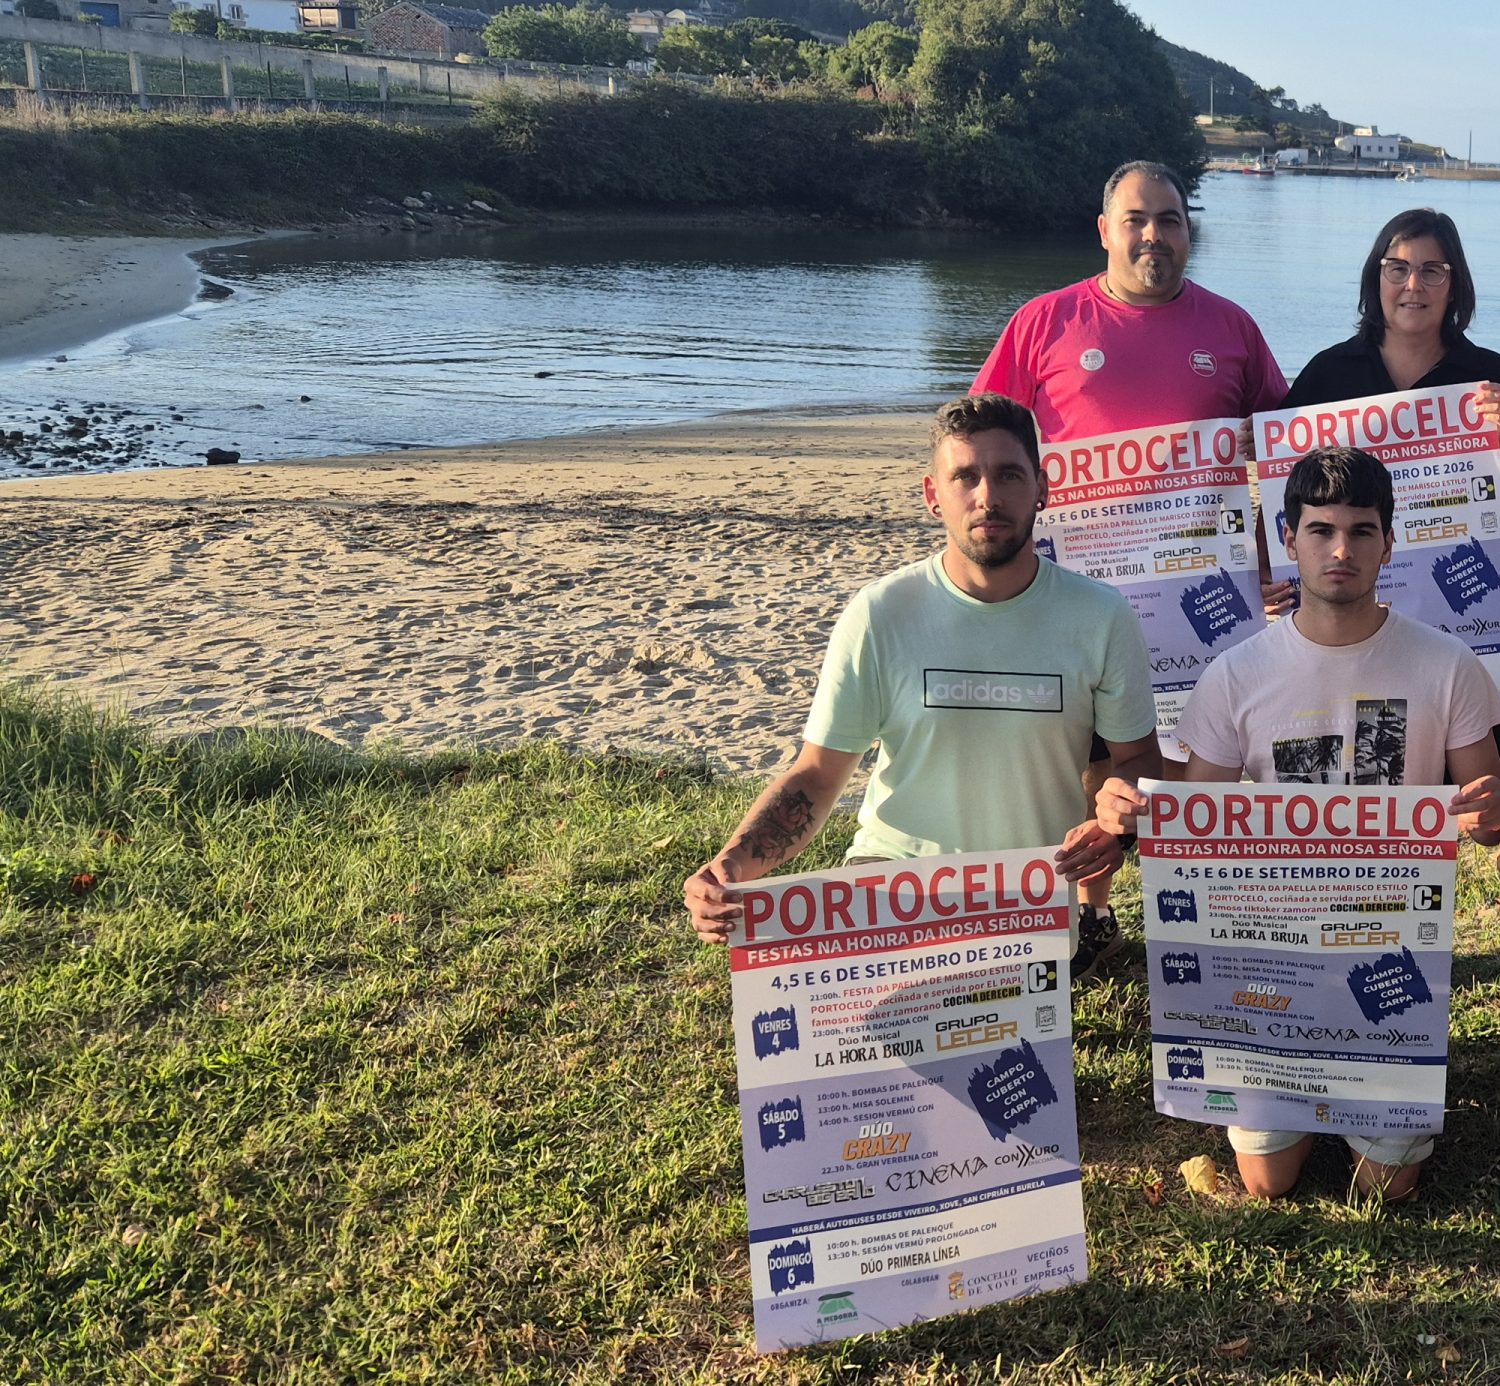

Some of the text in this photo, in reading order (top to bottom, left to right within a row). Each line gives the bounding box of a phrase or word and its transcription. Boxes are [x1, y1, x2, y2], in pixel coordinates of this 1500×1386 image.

[1264, 392, 1485, 457] PORTOCELO
[1041, 427, 1236, 489] ORTOCELO
[1382, 449, 1399, 460] DA
[1401, 443, 1435, 458] NOSA
[1439, 436, 1489, 452] SEÑORA
[1268, 462, 1293, 475] FEST
[1425, 464, 1440, 476] DE
[1443, 461, 1474, 474] 2026
[1068, 489, 1086, 501] NA
[1088, 484, 1132, 497] HONRA
[1135, 481, 1152, 491] DA
[1155, 475, 1188, 489] NOSA
[1190, 470, 1238, 485] SEÑORA
[1036, 494, 1224, 527] 4,5 E 6 DE SETEMBRO DE 2026
[933, 680, 1022, 702] adidas
[1152, 793, 1445, 838] PORTOCELO
[1154, 842, 1443, 856] FESTAS NA HONRA DA NOSA SEÑORA
[1174, 867, 1419, 880] 4,5 E 6 DE SETEMBRO DE 2026
[743, 859, 1055, 942] PORTOCELO
[748, 911, 1056, 964] FESTAS NA HONRA DA NOSA SEÑORA
[772, 943, 1032, 992] 4,5 E 6 DE SETEMBRO DE 2026
[844, 985, 874, 997] FESTA
[876, 983, 889, 993] DA
[892, 979, 927, 991] PAELLA
[930, 976, 942, 984] DE
[945, 970, 987, 982] MARISCO
[989, 964, 1021, 975] ESTILO
[811, 1000, 876, 1014] PORTOCELO,
[878, 993, 921, 1006] cociñada
[931, 986, 966, 997] servida
[969, 983, 984, 993] por
[987, 980, 997, 988] EL
[1000, 976, 1024, 985] PAPI,
[812, 1017, 849, 1027] famoso
[852, 1011, 890, 1022] tiktoker
[894, 1003, 941, 1017] zamorano
[943, 992, 979, 1008] COCINA
[758, 1019, 791, 1034] VENRES
[936, 1013, 998, 1033] GRUPO
[772, 1034, 780, 1048] 4
[839, 1032, 900, 1046] Dúo Musical
[815, 1040, 924, 1068] LA HORA BRUJA
[985, 1071, 1035, 1103] CUBERTO
[986, 1063, 1024, 1088] CAMPO
[1003, 1096, 1038, 1120] CARPA
[1004, 1089, 1027, 1105] CON
[763, 1109, 798, 1125] SÁBADO
[778, 1125, 785, 1139] 5
[859, 1120, 893, 1139] DÚO
[842, 1132, 912, 1161] CRAZY
[886, 1157, 988, 1192] CINEMA
[792, 1222, 824, 1235] HABERÁ
[826, 1215, 875, 1229] AUTOBUSES
[877, 1211, 902, 1222] DESDE
[904, 1205, 938, 1218] VIVEIRO,
[963, 1195, 978, 1204] SAN
[980, 1188, 1010, 1200] CIPRIÁN
[1017, 1180, 1045, 1192] BURELA
[769, 1252, 812, 1270] DOMINGO
[860, 1245, 960, 1275] DÚO PRIMERA LÍNEA
[1028, 1246, 1069, 1262] VECIÑOS
[1046, 1260, 1051, 1268] E
[788, 1269, 795, 1285] 6
[1024, 1264, 1075, 1283] EMPRESAS
